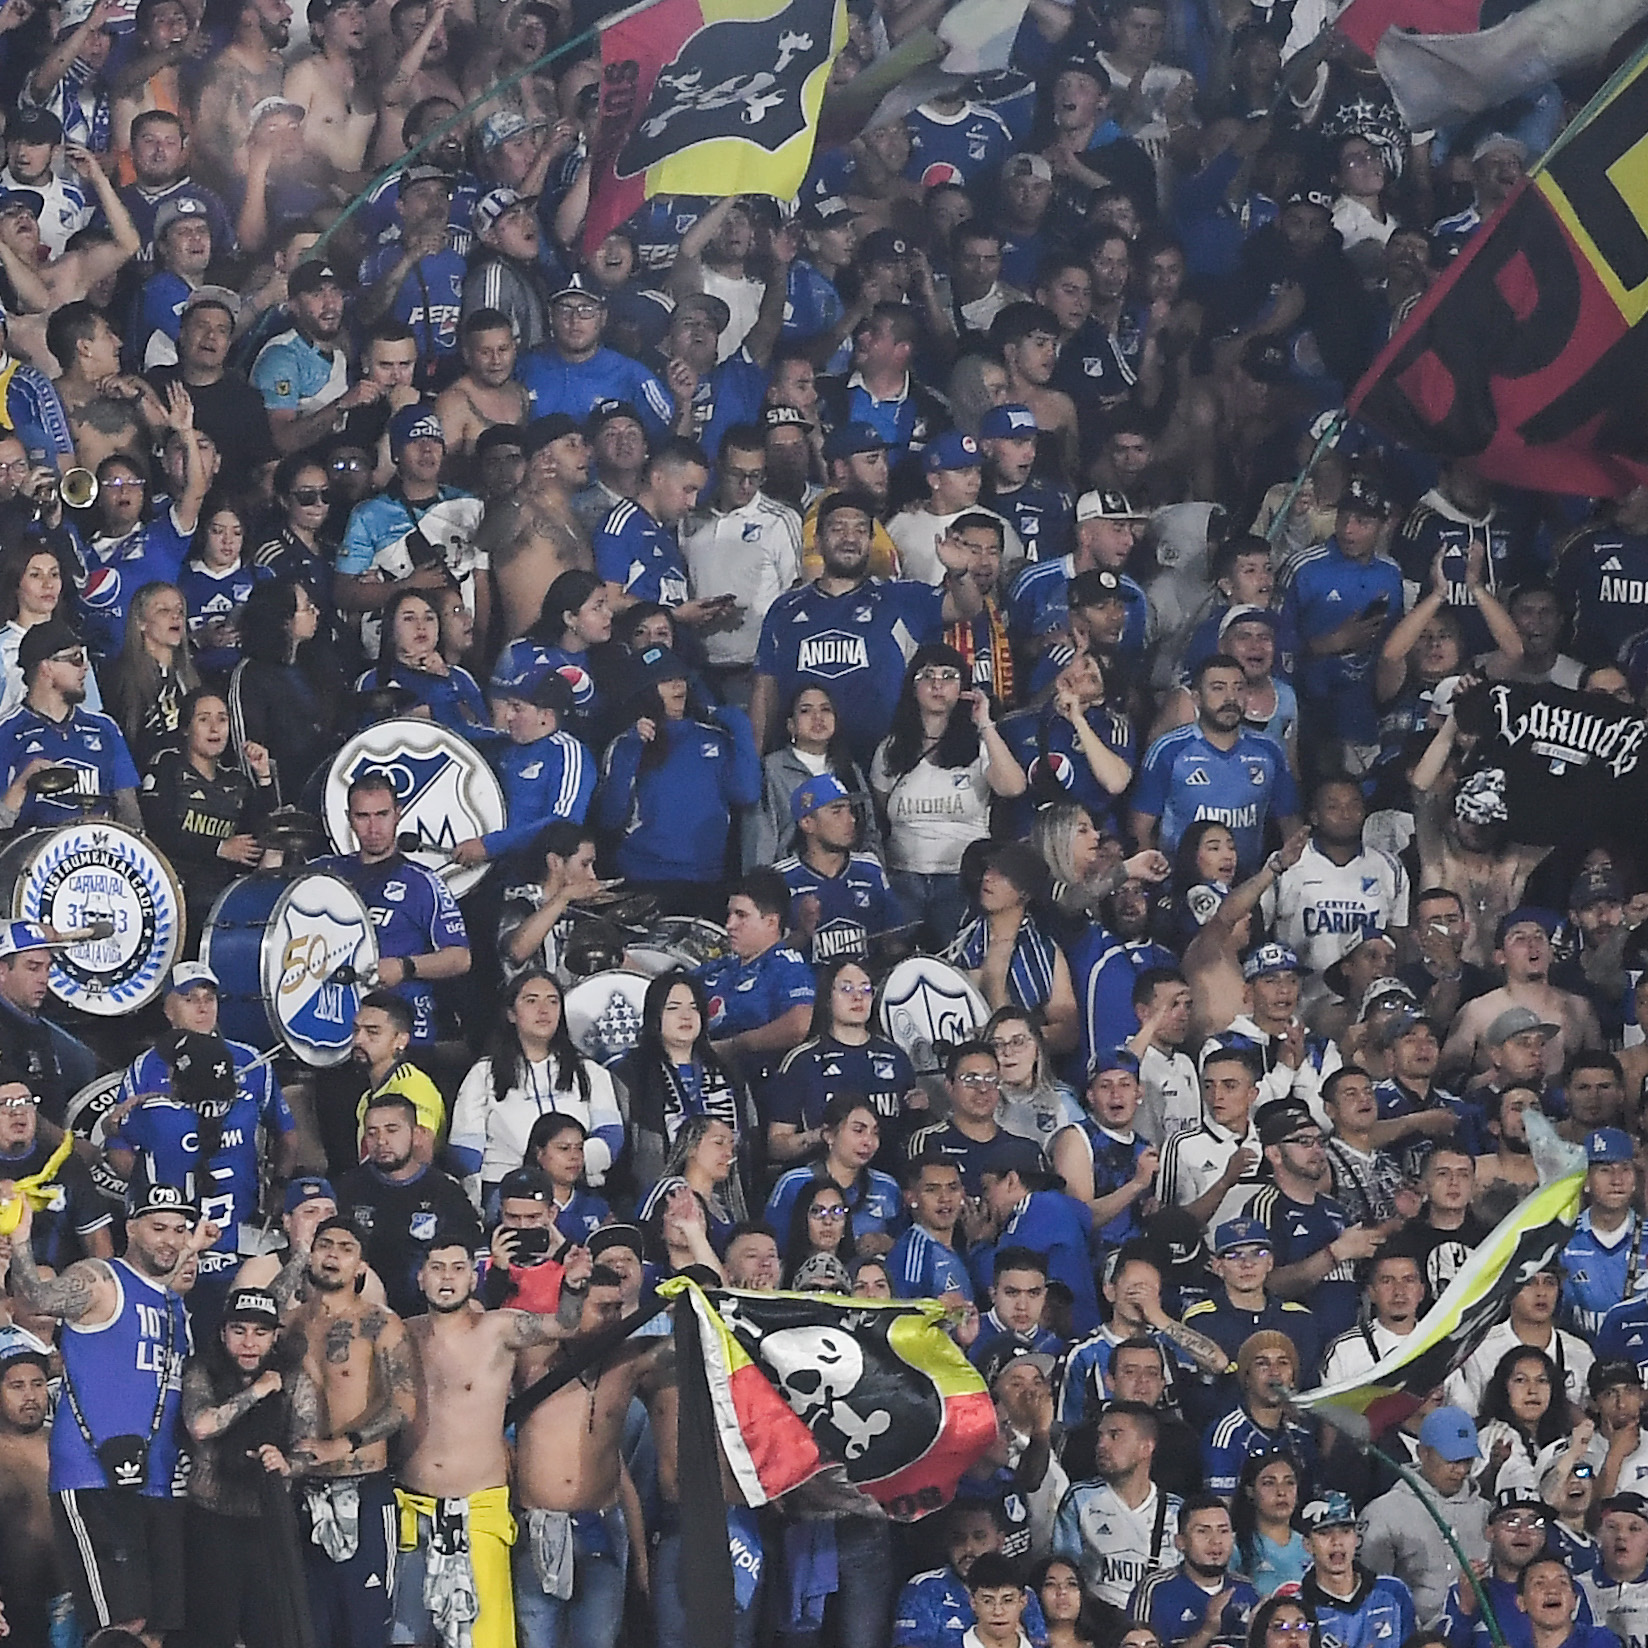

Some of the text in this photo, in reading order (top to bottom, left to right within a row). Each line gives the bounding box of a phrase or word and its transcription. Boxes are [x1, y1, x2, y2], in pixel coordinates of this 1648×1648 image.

[800, 639, 865, 667] ANDINA
[896, 796, 964, 817] ANDINA
[1194, 804, 1256, 829] ANDINA
[1317, 901, 1366, 912] CERVEZA
[135, 1303, 161, 1336] 10
